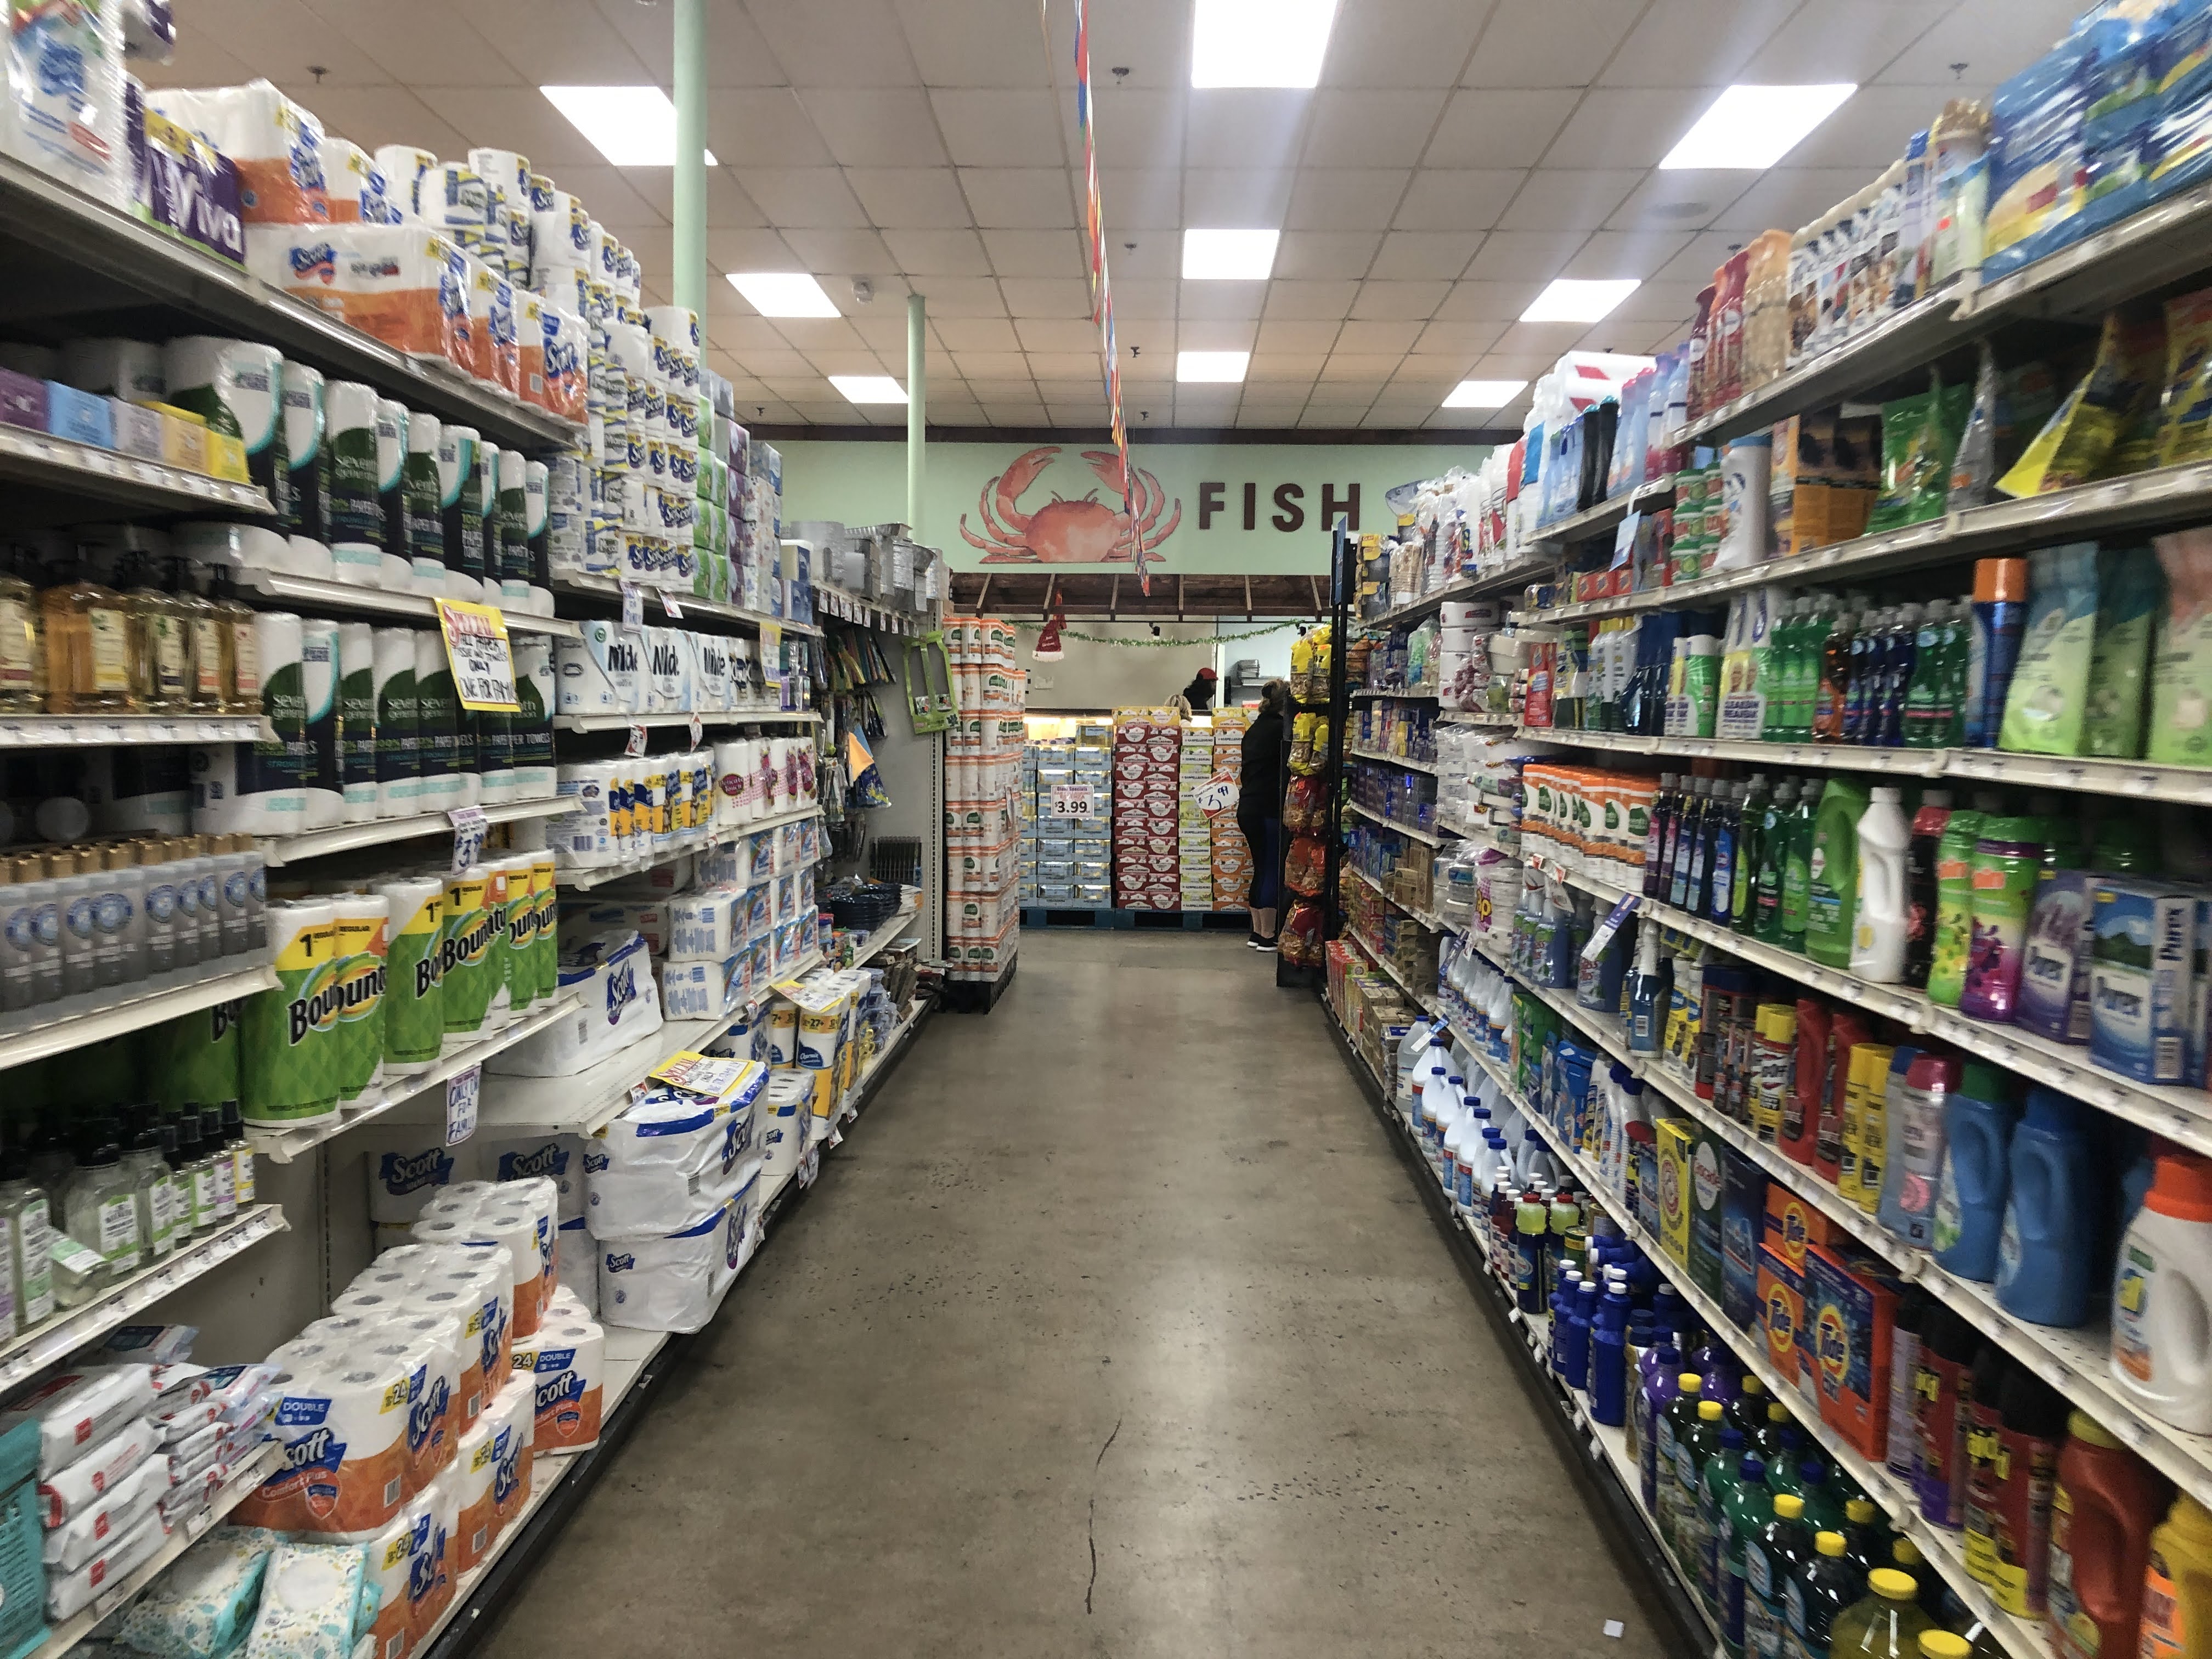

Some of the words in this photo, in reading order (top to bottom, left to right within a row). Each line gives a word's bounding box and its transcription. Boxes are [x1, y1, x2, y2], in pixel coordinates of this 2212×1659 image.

[1199, 482, 1361, 532] FISH
[449, 887, 460, 906] 1
[425, 902, 435, 923] 1
[299, 933, 313, 957] 1
[392, 1150, 441, 1183] Scott
[512, 1144, 556, 1180] Scott
[585, 1155, 605, 1166] Scott
[610, 1254, 629, 1267] Scott
[512, 1352, 533, 1369] 24
[539, 1351, 572, 1363] DOUBLE
[392, 1380, 408, 1405] 24
[536, 1372, 574, 1408] cott
[283, 1402, 325, 1413] DOUBLE
[285, 1427, 330, 1467] cott
